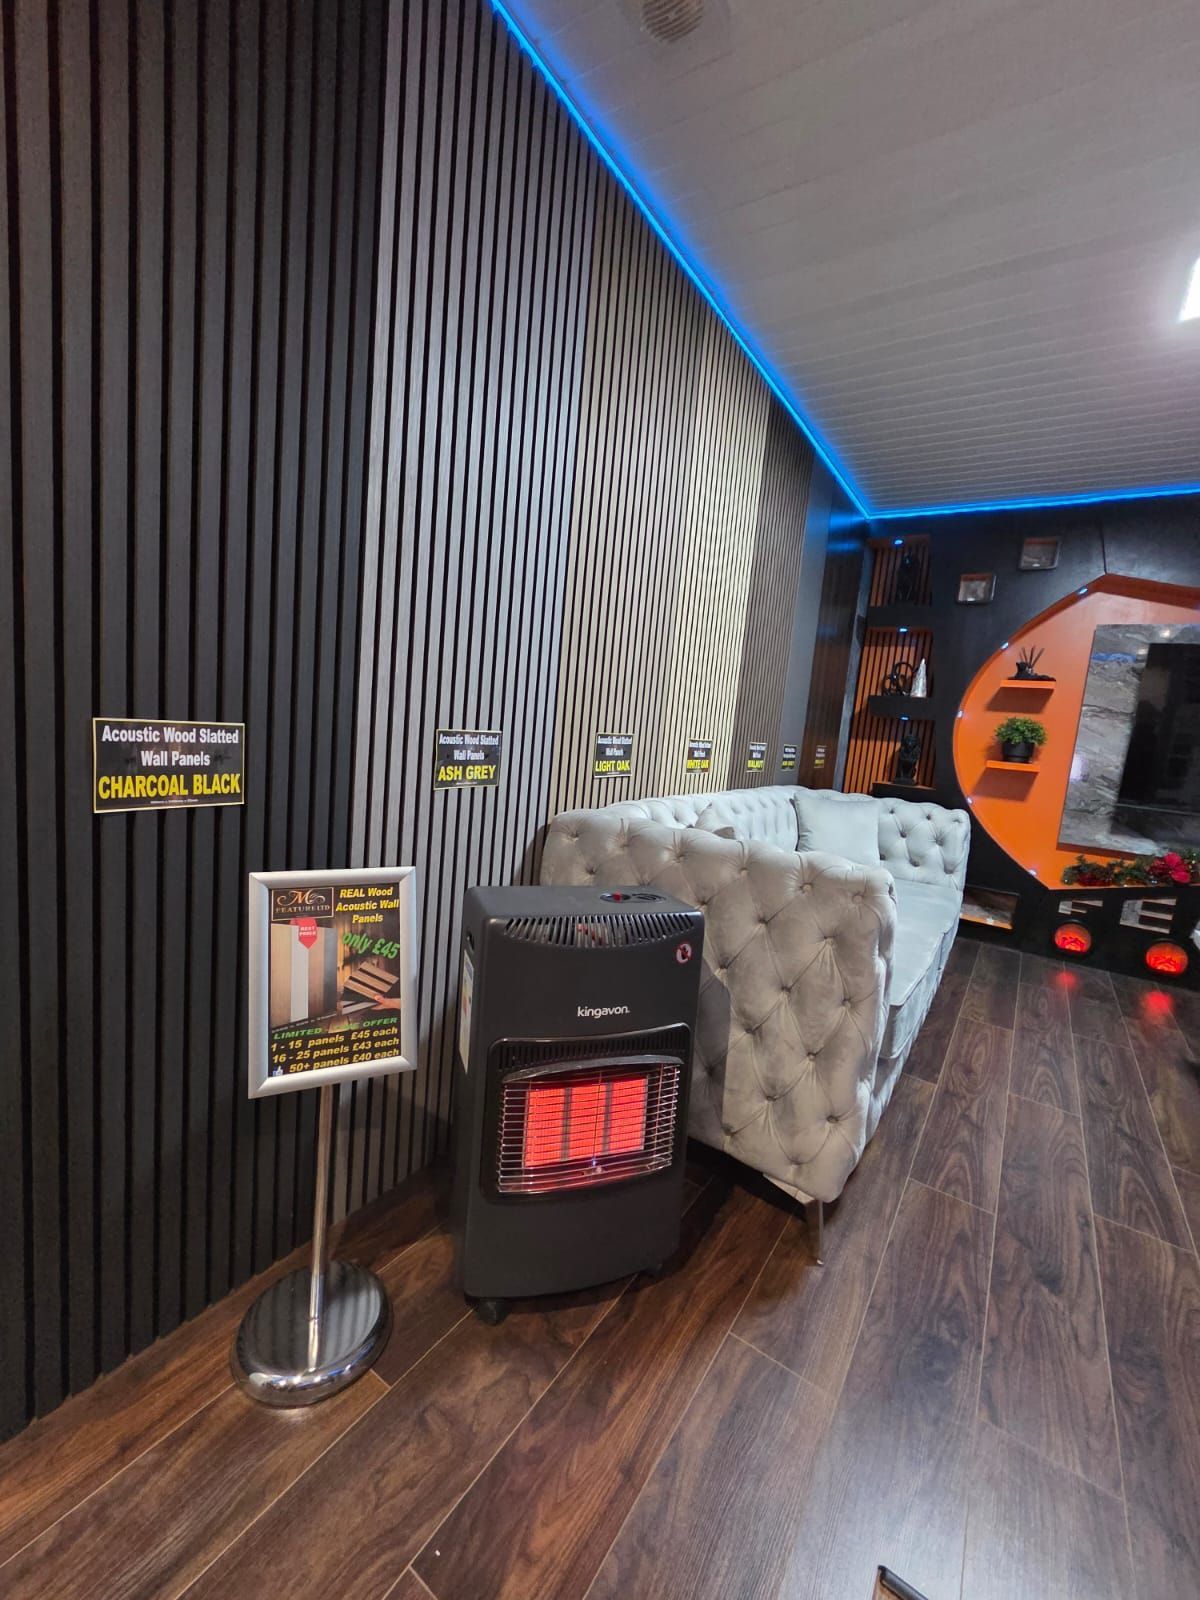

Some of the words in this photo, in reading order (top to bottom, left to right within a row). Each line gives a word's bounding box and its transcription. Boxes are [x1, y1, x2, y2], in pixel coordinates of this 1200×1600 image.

[102, 725, 160, 743] Acoustic
[163, 727, 197, 743] Wood
[199, 728, 239, 744] Slatted
[141, 750, 168, 767] Wall
[171, 751, 210, 767] Panels
[595, 760, 616, 772] LIGHT
[616, 760, 631, 771] OAK
[438, 765, 463, 782] ASH
[465, 764, 497, 780] GREY
[98, 774, 189, 799] CHARCOAL
[192, 773, 241, 795] BLACK
[340, 888, 366, 899] REAL
[367, 886, 394, 897] Wood
[335, 901, 378, 912] Acoustic
[379, 899, 400, 909] Wall
[352, 913, 384, 924] Panels
[342, 932, 373, 955] only
[372, 938, 401, 960] £45
[273, 1027, 323, 1040] LIMITED
[362, 1017, 398, 1028] OFFER
[271, 1042, 278, 1052] 1
[288, 1039, 303, 1050] 15
[307, 1034, 345, 1049] panels
[350, 1030, 371, 1041] £45
[372, 1026, 399, 1038] each
[272, 1053, 287, 1064] 16
[295, 1049, 312, 1061] 25
[312, 1045, 350, 1060] panels
[352, 1041, 373, 1052] £43
[374, 1037, 400, 1048] each
[289, 1062, 312, 1073] 50+
[312, 1056, 350, 1071] panels
[351, 1052, 373, 1064] £40
[373, 1048, 400, 1060] each
